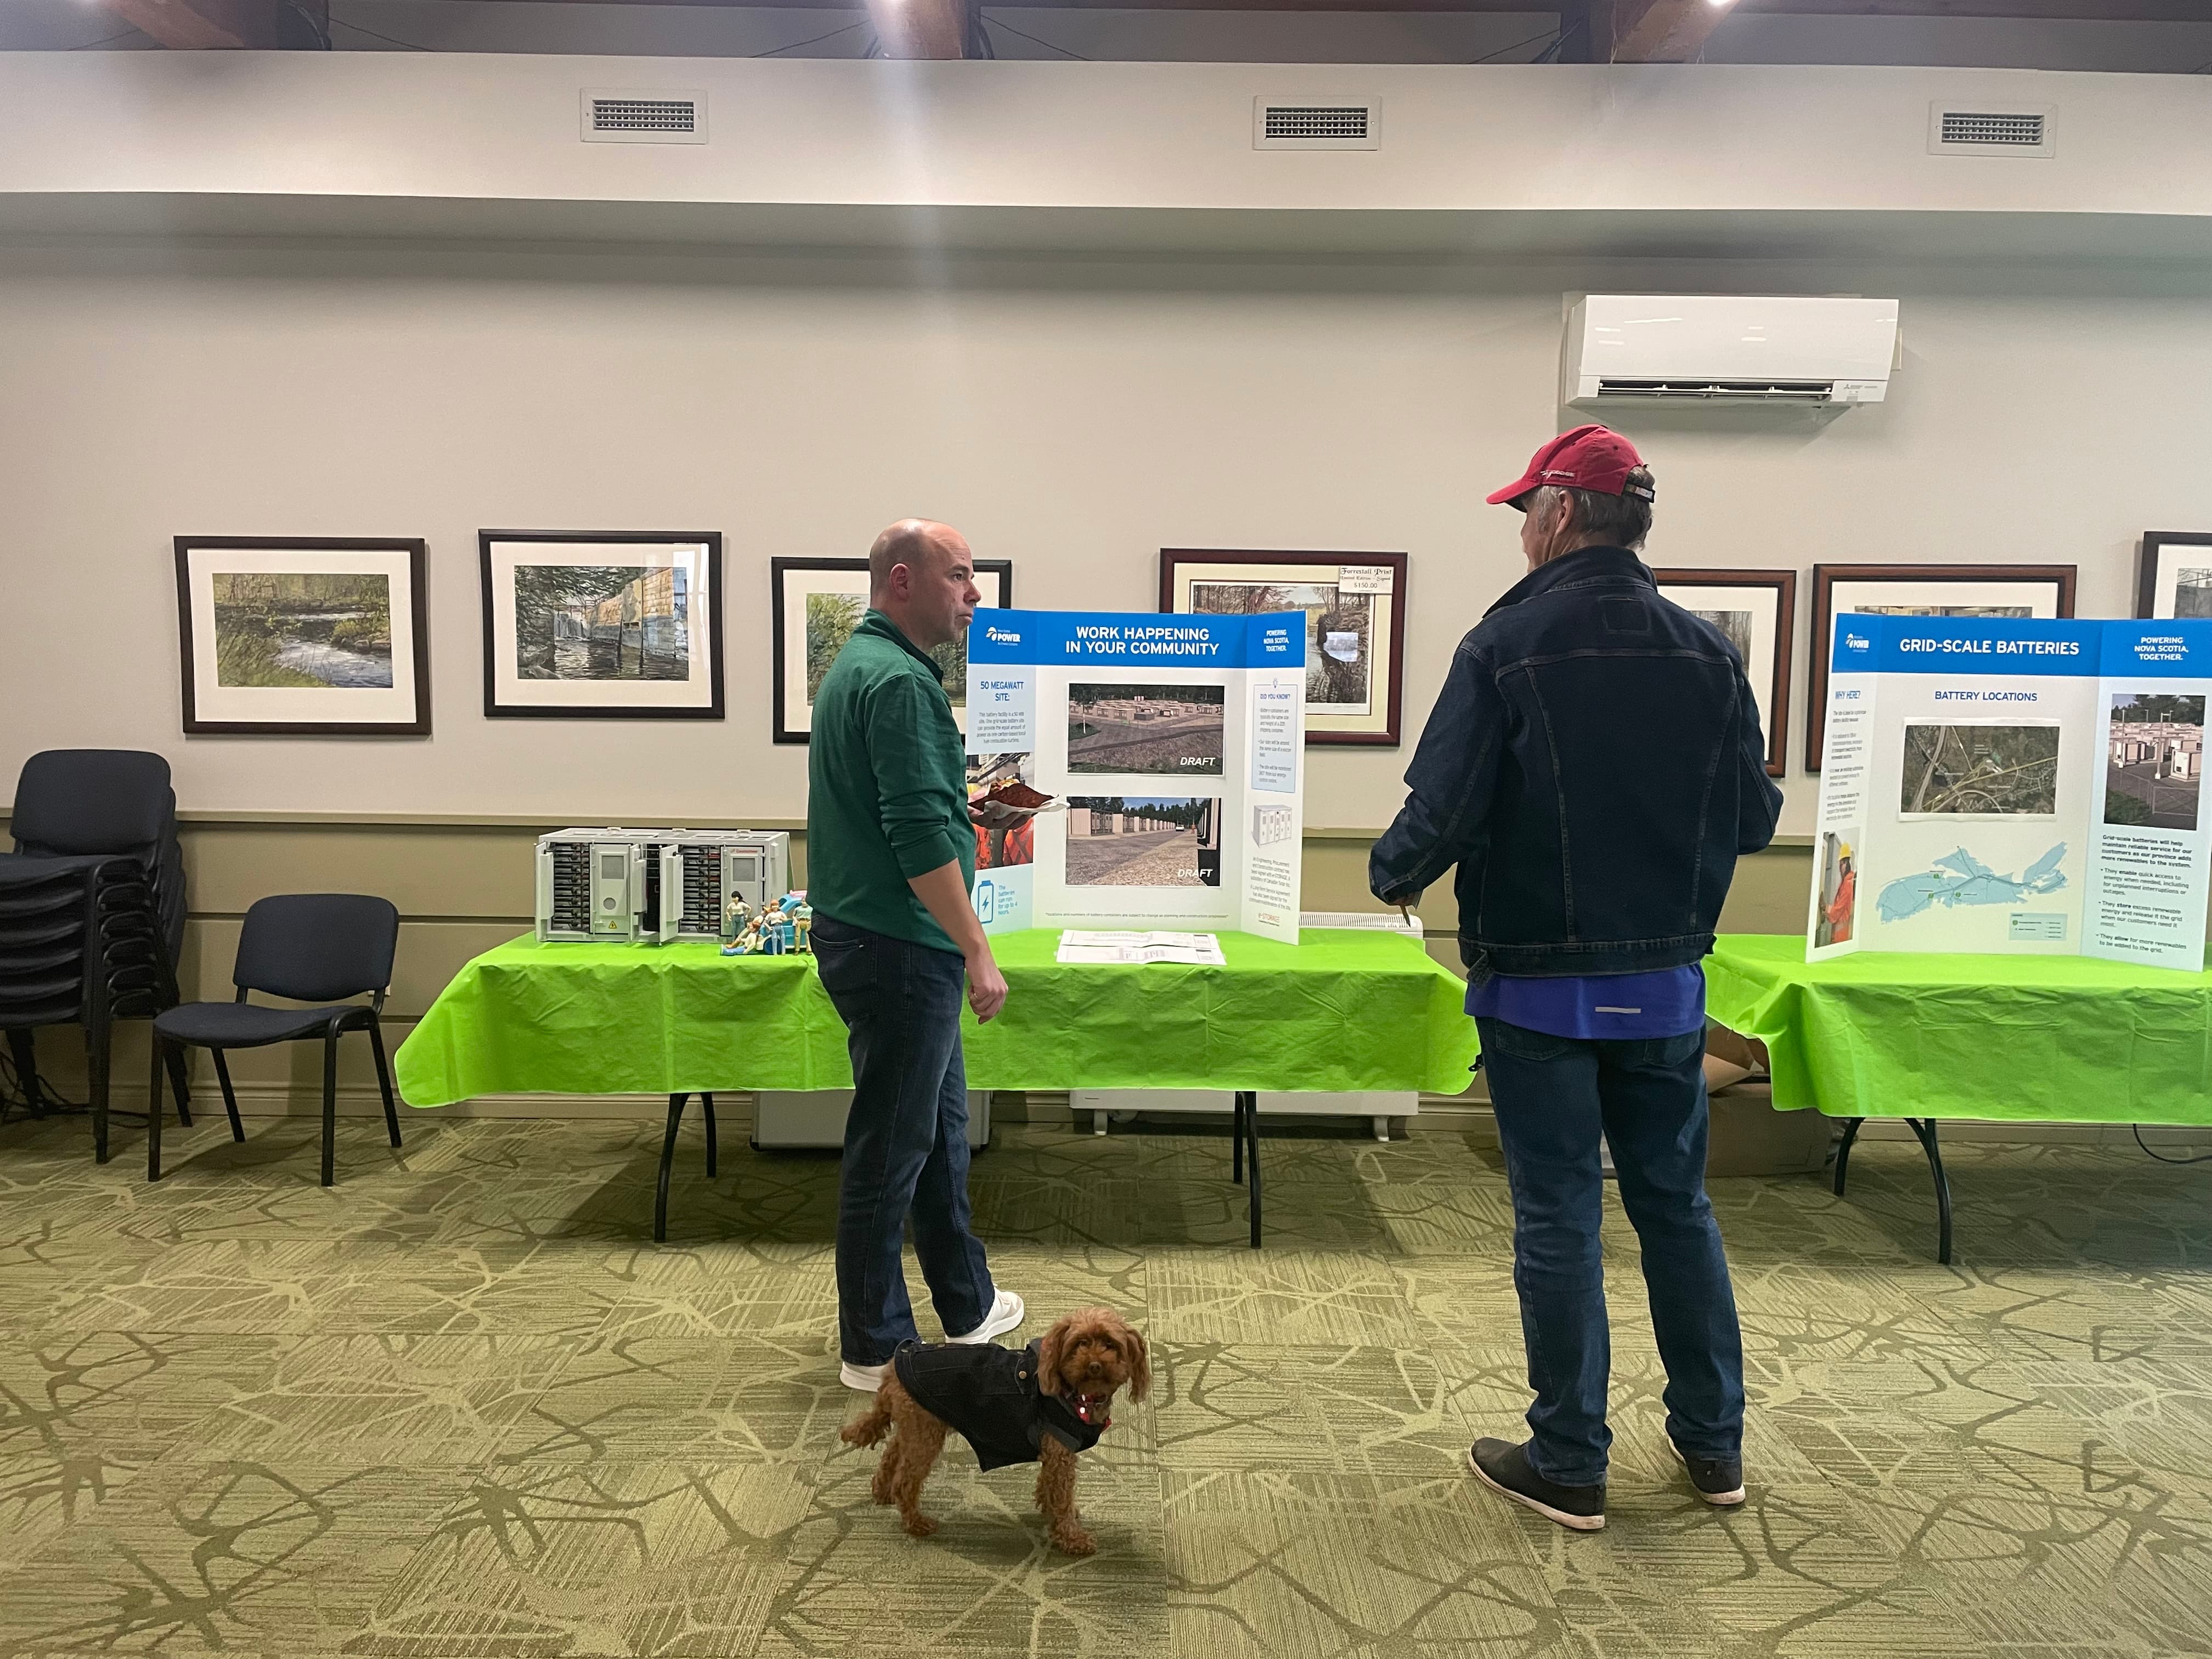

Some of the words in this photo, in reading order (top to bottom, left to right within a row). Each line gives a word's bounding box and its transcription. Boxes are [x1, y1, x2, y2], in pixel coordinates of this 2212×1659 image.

[997, 633, 1020, 642] POWER
[1076, 627, 1120, 639] WORK
[1125, 627, 1209, 641] HAPPENING
[1065, 641, 1080, 653] IN
[1085, 641, 1126, 654] YOUR
[1131, 642, 1219, 655] COMMUNITY
[1900, 639, 1991, 653] GRID-SCALE
[1996, 641, 2079, 655] BATTERIES
[995, 693, 1010, 701] SITE:
[1935, 691, 1980, 701] BATTERY
[1983, 692, 2038, 701] LOCATIONS
[1180, 757, 1216, 766] DRAFT
[1177, 868, 1213, 877] DRAFT
[2142, 885, 2179, 894] interruptions
[2155, 941, 2186, 949] renewables
